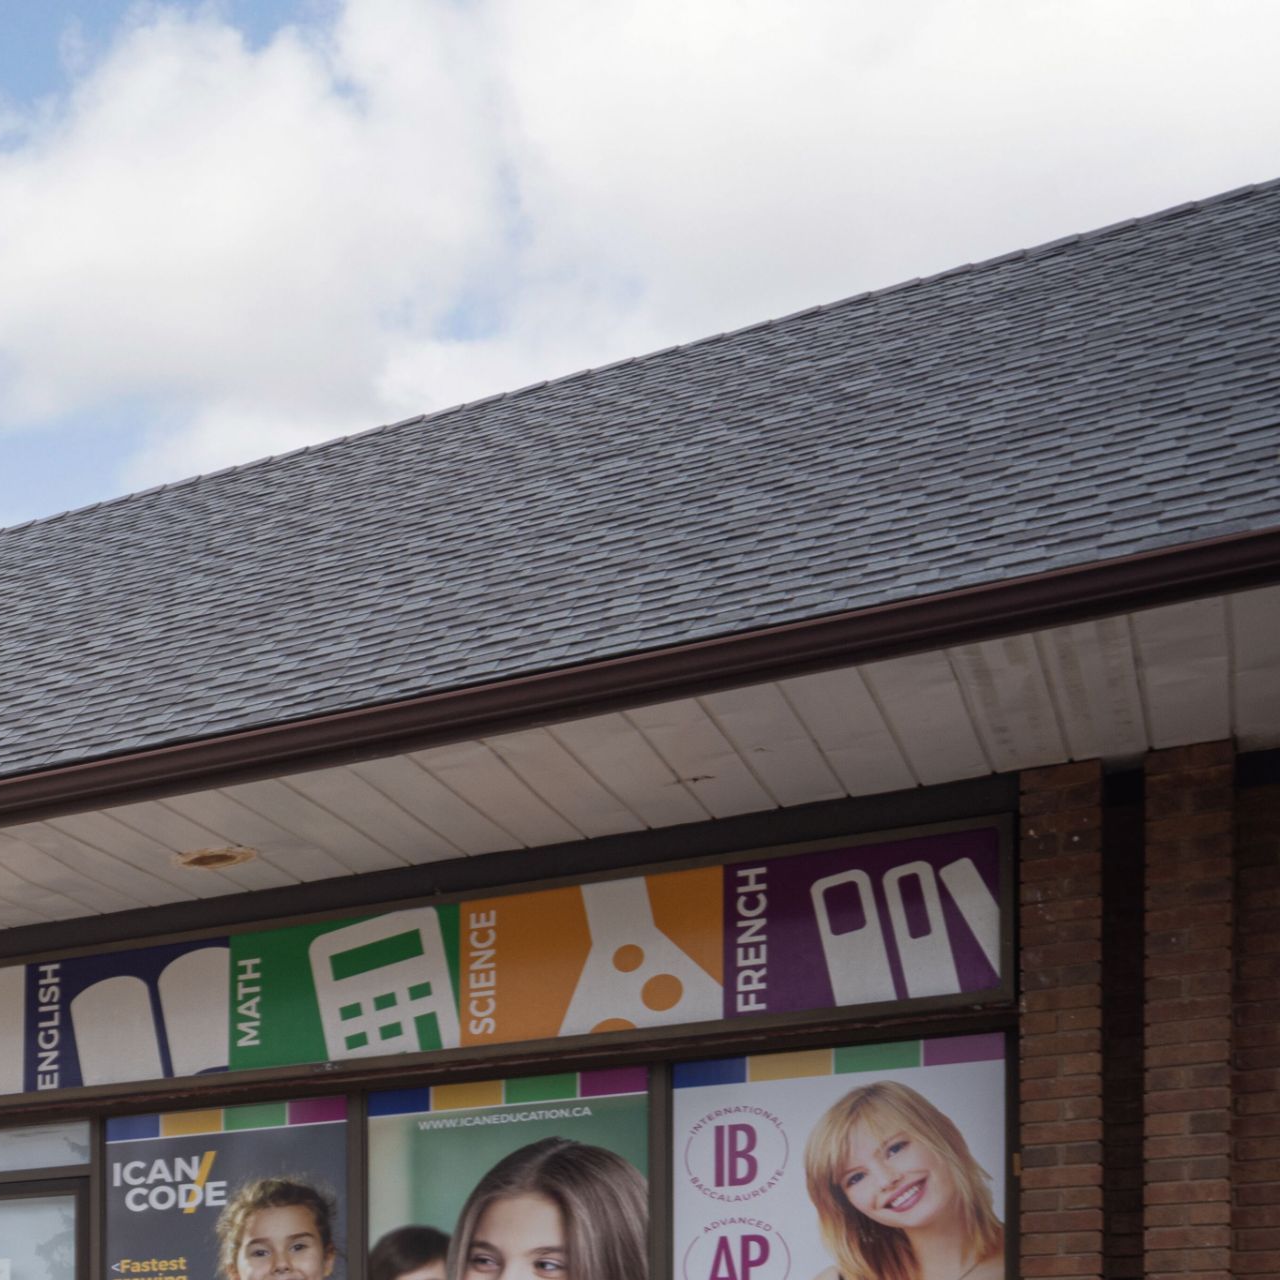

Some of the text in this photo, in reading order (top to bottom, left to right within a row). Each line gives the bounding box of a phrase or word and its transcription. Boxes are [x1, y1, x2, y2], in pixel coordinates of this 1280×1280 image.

[736, 866, 767, 1011] FRENCH
[470, 909, 496, 1035] SCIENCE
[237, 957, 261, 1047] MATH
[36, 963, 61, 1091] ENGLISH
[418, 1106, 592, 1130] WWW.ICANEDUCATION.CA
[689, 1105, 783, 1135] INTERNATIONAL
[714, 1123, 758, 1187] IB
[125, 1181, 227, 1212] CODE
[690, 1169, 783, 1203] BACCALAUREATE
[703, 1217, 772, 1233] ADVANCED
